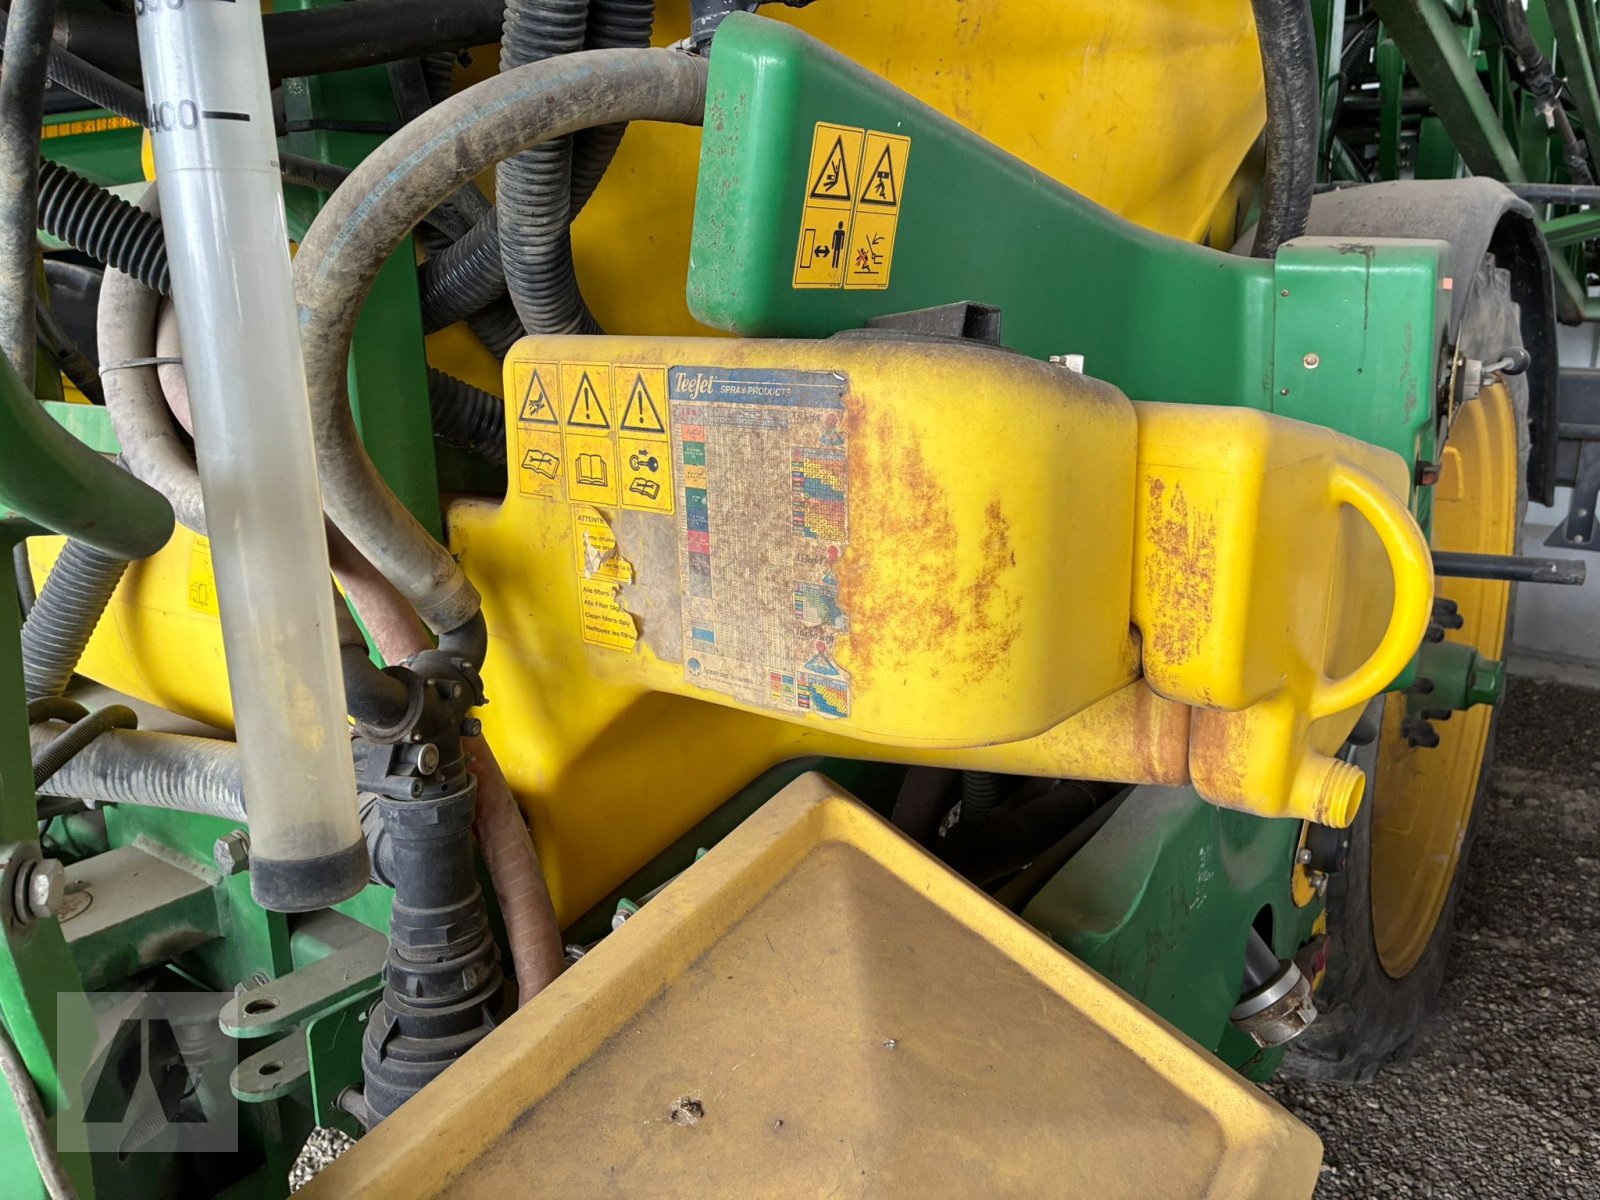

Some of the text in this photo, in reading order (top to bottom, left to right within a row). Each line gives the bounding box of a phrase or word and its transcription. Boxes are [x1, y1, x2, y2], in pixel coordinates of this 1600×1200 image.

[150, 99, 199, 133] 400
[720, 385, 745, 395] SPRAY
[747, 386, 792, 397] PRODUCTS
[585, 611, 601, 620] Clean
